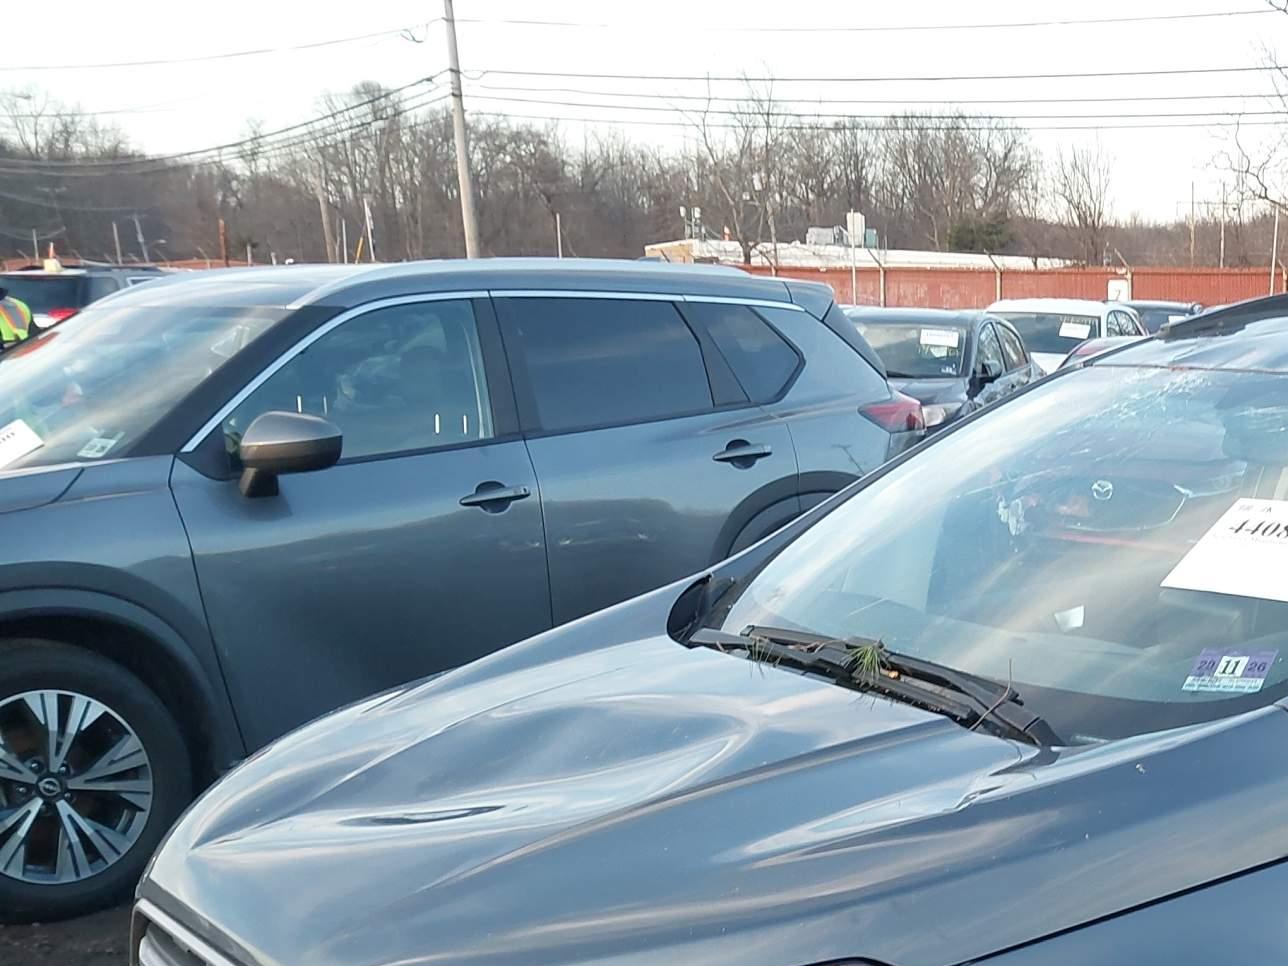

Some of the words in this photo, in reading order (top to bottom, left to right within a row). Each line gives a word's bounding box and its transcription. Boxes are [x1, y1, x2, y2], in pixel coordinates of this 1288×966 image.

[1197, 659, 1216, 671] 20
[1220, 659, 1241, 674] 11
[1247, 661, 1267, 672] 26
